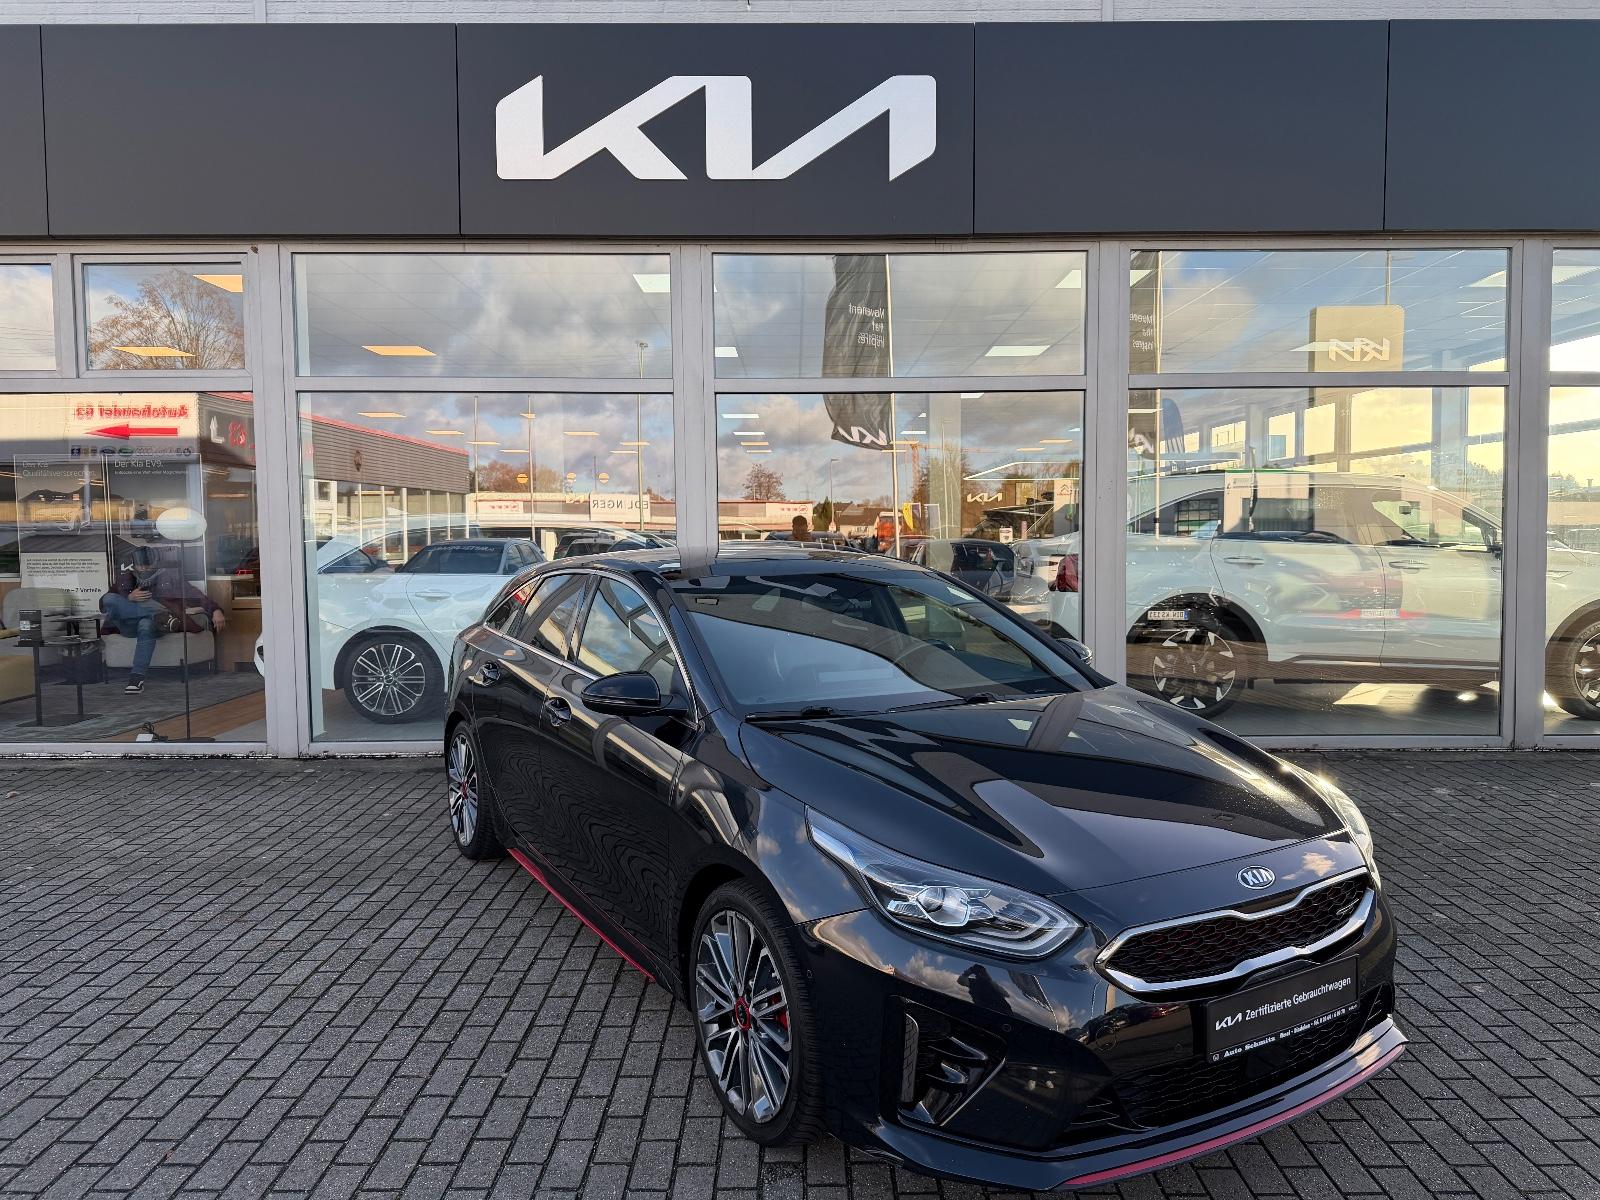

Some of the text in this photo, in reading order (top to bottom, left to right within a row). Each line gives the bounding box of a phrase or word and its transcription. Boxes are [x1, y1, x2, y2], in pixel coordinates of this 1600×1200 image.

[496, 75, 936, 182] KIA
[114, 459, 128, 468] Der
[1243, 868, 1273, 886] KIA
[1215, 976, 1351, 1031] KIA Zertifizierte Gebrauchtwagen
[1223, 1047, 1243, 1058] Auto
